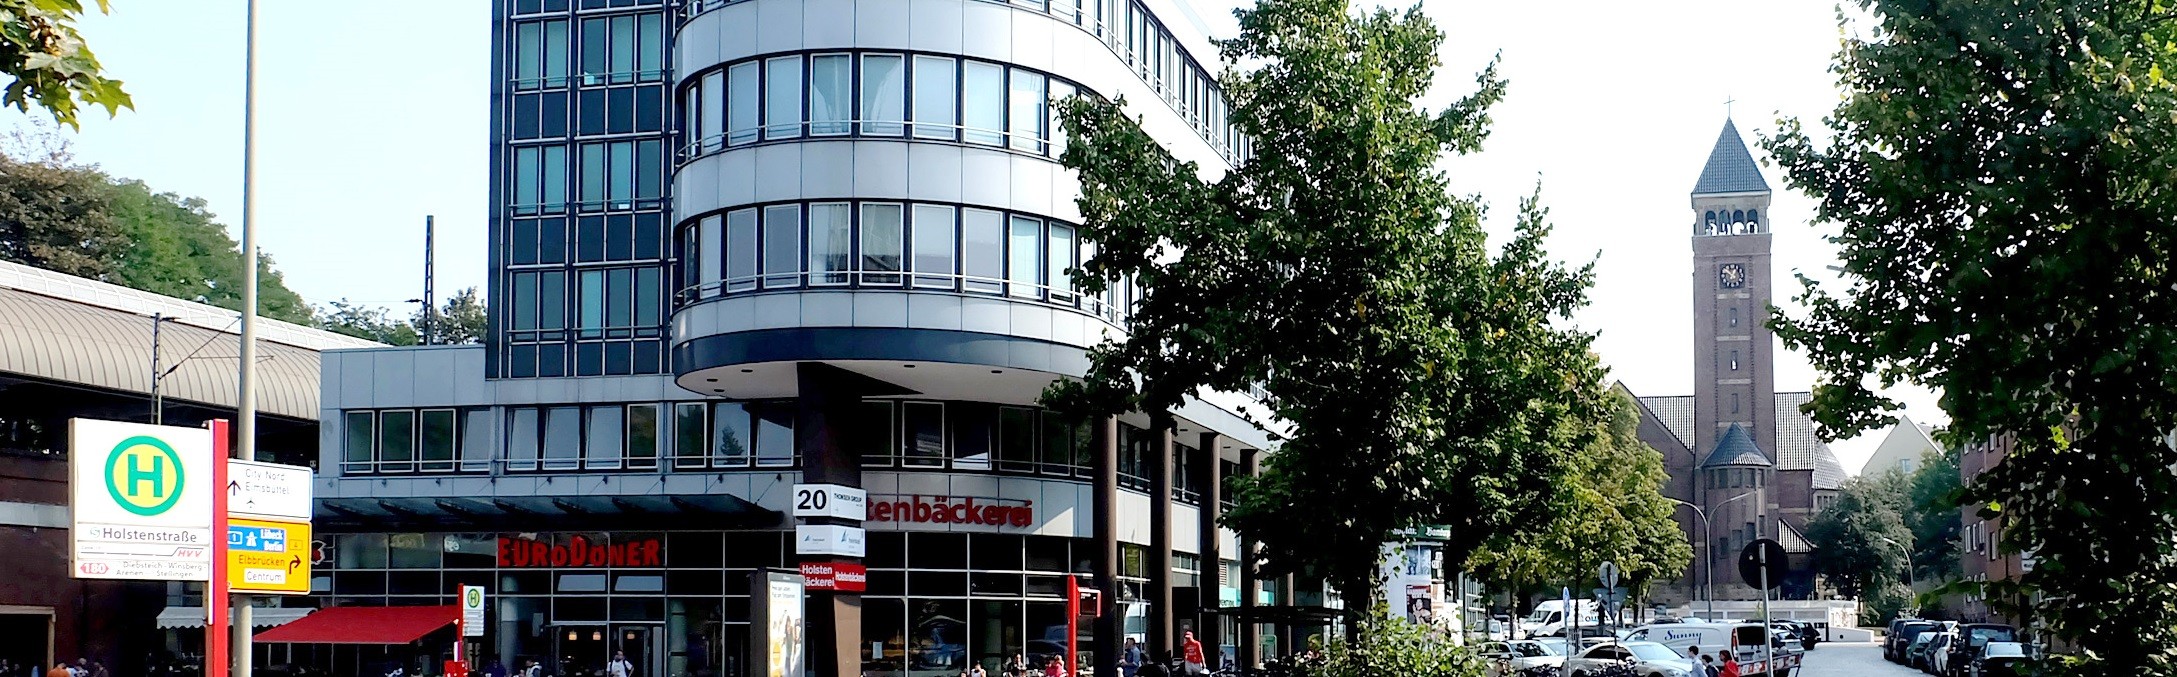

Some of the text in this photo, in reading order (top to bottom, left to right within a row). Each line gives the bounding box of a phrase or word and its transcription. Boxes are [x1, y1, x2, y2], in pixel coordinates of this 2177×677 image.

[128, 454, 163, 497] H
[245, 468, 285, 482] City Nord
[797, 489, 827, 510] 20
[103, 527, 197, 543] Holstenstraße
[238, 554, 286, 567] Elbbrücken
[82, 563, 106, 575] 180
[246, 570, 282, 581] Centrum
[802, 564, 833, 575] Holsten
[803, 577, 835, 587] äckerei
[1664, 629, 1702, 645] Sunny
